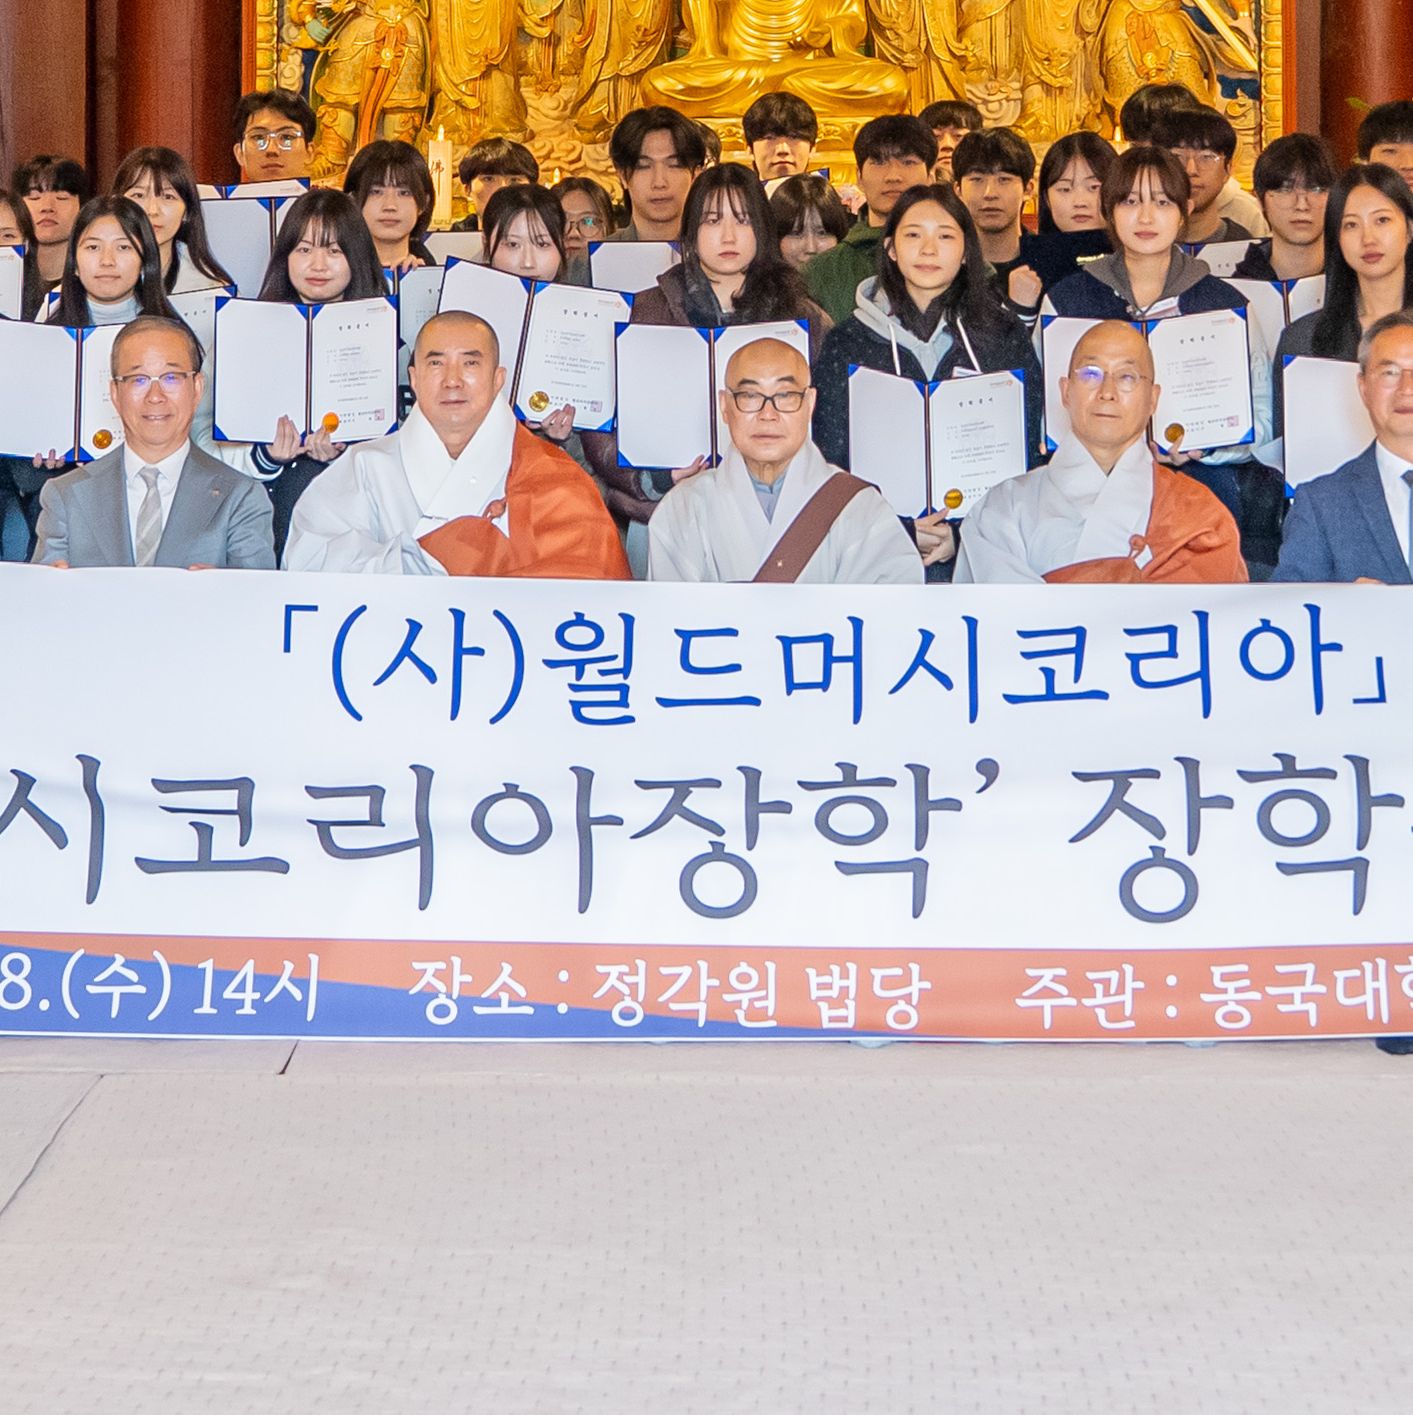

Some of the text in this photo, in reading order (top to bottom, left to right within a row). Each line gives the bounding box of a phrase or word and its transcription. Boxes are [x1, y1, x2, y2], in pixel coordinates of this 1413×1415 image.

[283, 602, 1388, 726] 「(사)월드머시코리아」
[193, 953, 320, 1022] 14시
[408, 955, 535, 1026] 장소
[592, 958, 778, 1029] 정각원
[805, 961, 933, 1031] 법당
[1015, 963, 1145, 1031] 주관
